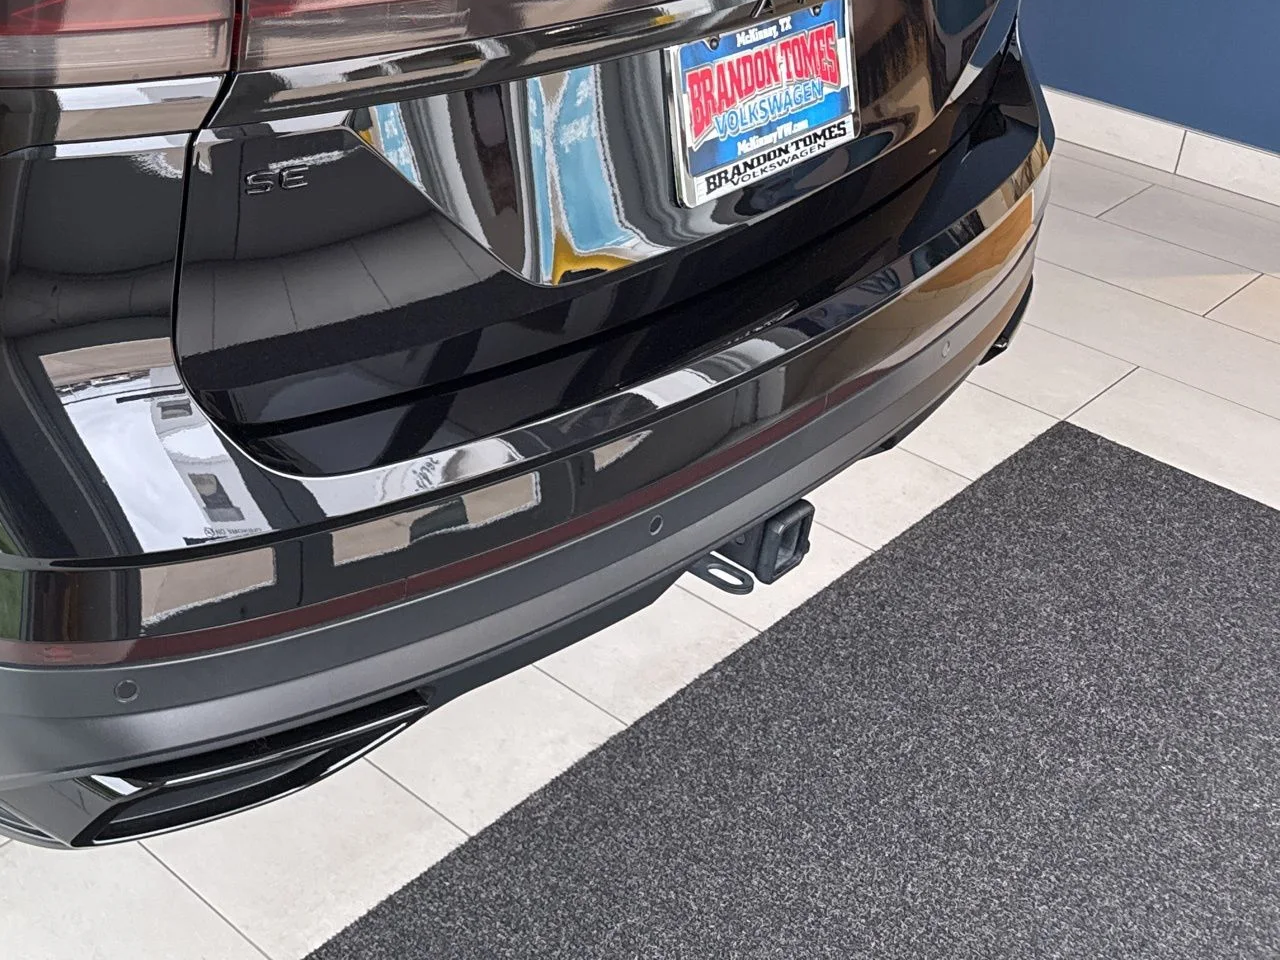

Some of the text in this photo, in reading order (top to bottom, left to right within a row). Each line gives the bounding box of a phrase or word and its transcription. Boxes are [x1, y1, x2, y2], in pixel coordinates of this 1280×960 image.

[778, 15, 793, 33] TX
[685, 43, 781, 141] BRANDON
[780, 21, 841, 86] TOMES
[714, 78, 826, 137] VOLKSWAGEN
[244, 163, 310, 196] SE
[704, 120, 848, 196] BRANDON TOMES
[729, 141, 828, 187] VOLKSWAGEN
